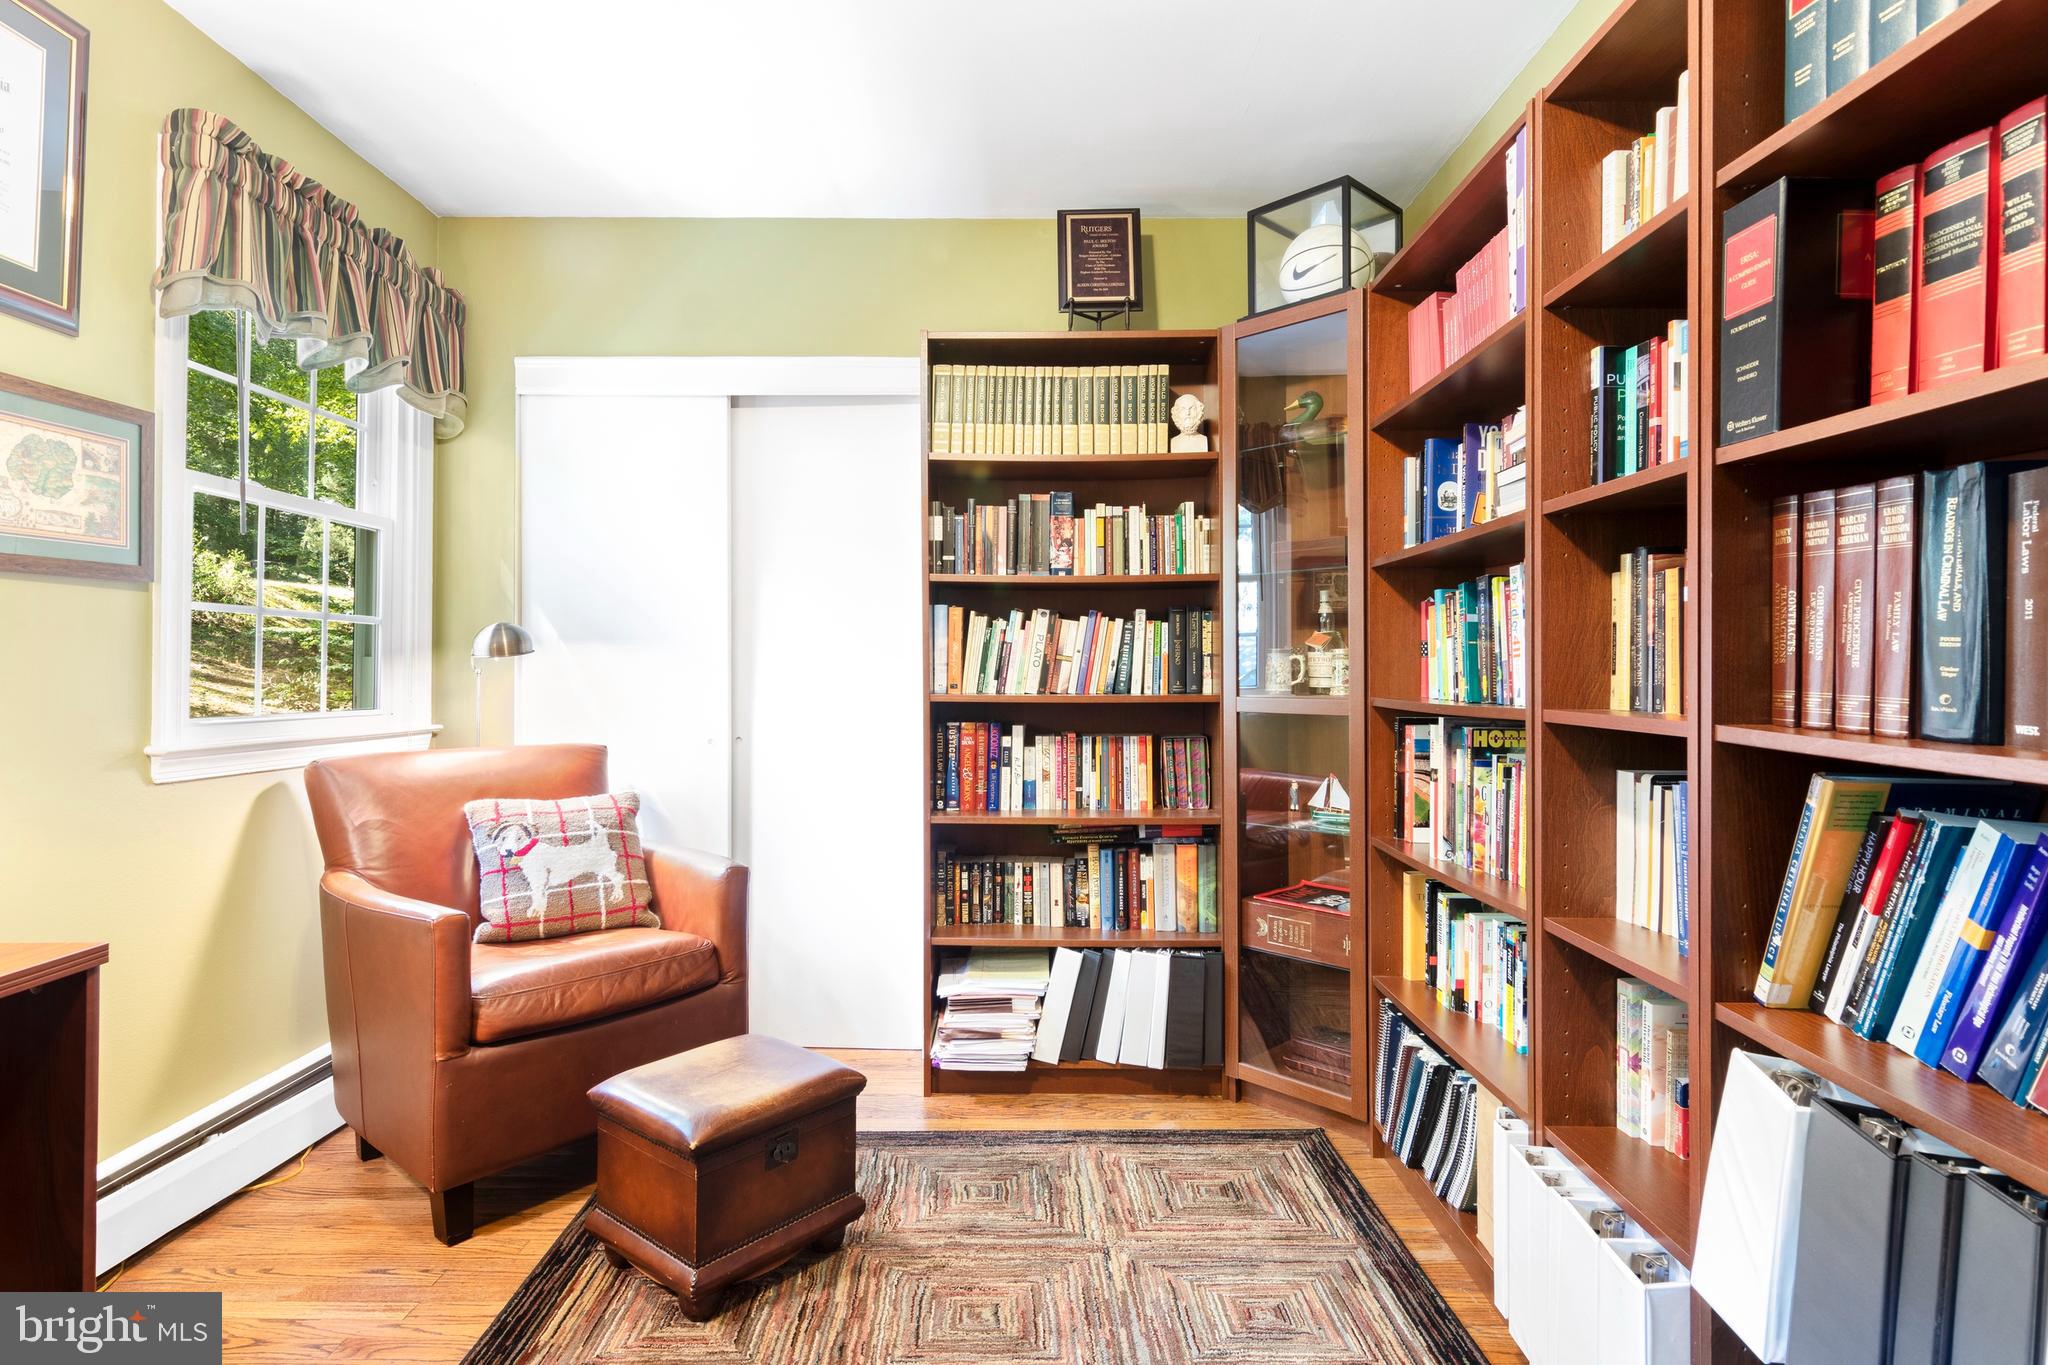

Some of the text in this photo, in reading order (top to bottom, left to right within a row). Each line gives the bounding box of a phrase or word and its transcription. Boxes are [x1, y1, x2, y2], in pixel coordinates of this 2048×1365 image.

[1080, 225, 1112, 234] RUTGERS
[1965, 216, 1977, 226] OF
[2010, 212, 2028, 224] AND
[1730, 315, 1767, 335] FOURTH EDITION
[1734, 418, 1753, 429] Wolters
[1753, 414, 1769, 425] Kluwer
[1839, 513, 1867, 526] MARCUS
[1883, 505, 1907, 516] KRAUSE
[1885, 515, 1904, 525] ELROD
[2032, 500, 2040, 533] Federal
[1838, 533, 1869, 546] SHERMAN
[1841, 524, 1865, 535] REDISH
[2021, 500, 2033, 575] Labor Laws
[1936, 496, 1958, 622] READINGS IN CRIMINAL LAW
[1511, 586, 1519, 634] Toddler
[1953, 592, 1962, 613] AND
[2024, 598, 2034, 620] 2011
[1779, 586, 1788, 664] TRANSACTIONS
[1787, 590, 1797, 655] CONTRACTS:
[1815, 585, 1825, 661] CORPORATIONS
[1851, 578, 1862, 668] CIVIL PROCEDURE
[1891, 591, 1902, 653] FAMILY LAW
[1032, 634, 1045, 668] PLATO
[1173, 639, 1183, 666] INFERNO
[1808, 628, 1816, 655] POLICY
[1119, 665, 1129, 681] RIVER
[1635, 653, 1643, 688] TOOBIN
[948, 725, 956, 759] JUSTICE
[990, 727, 998, 758] KOONTZ
[1793, 809, 1811, 855] SAMAHA
[1850, 830, 1879, 894] HAPPY HOUR
[1777, 858, 1798, 914] CRIMINAL
[1882, 848, 1914, 919] LEGAL WRITING
[1819, 921, 1845, 983] The Philadelphia Lawyer
[1928, 988, 1954, 1035] Fiduciary Law
